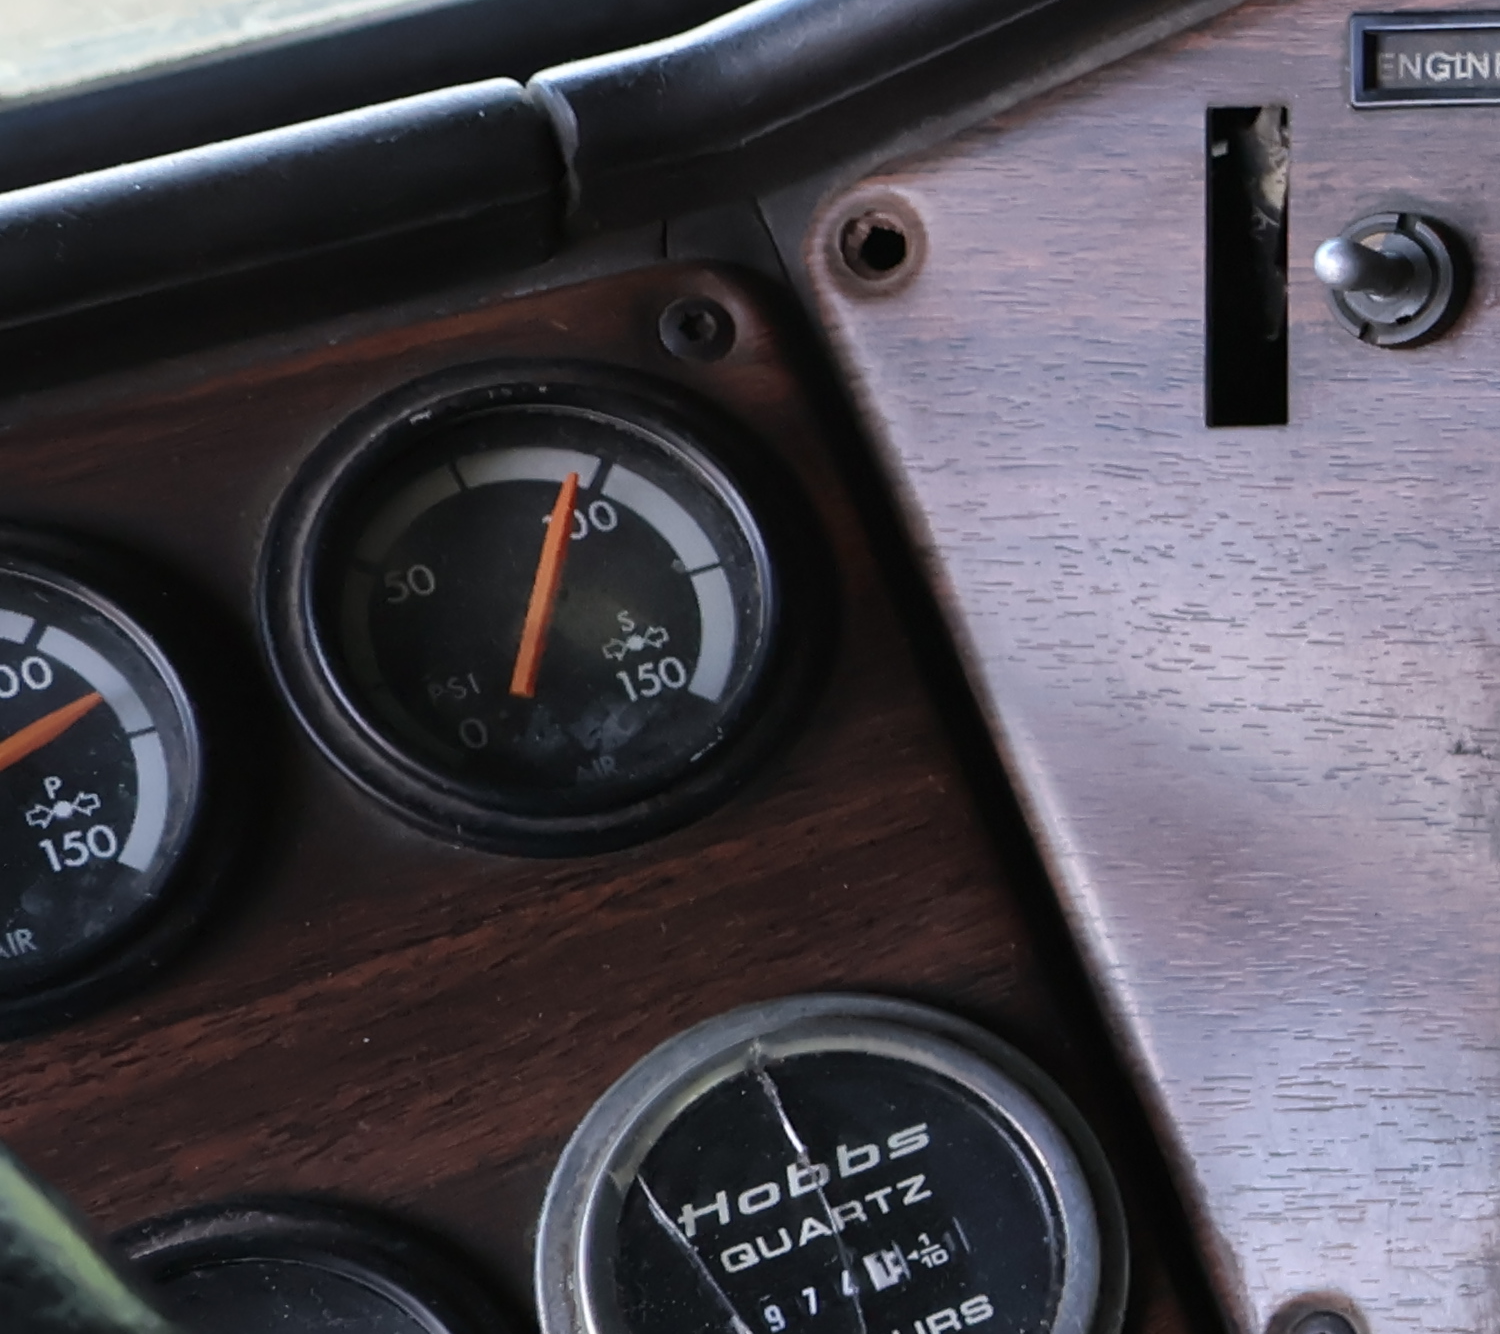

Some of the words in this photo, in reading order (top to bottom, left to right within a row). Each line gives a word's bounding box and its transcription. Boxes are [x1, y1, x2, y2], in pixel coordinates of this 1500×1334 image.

[383, 564, 436, 604] 50
[616, 656, 687, 703] 150
[43, 775, 63, 800] P
[38, 824, 118, 873] 150
[677, 1120, 930, 1237] Hobbs
[720, 1175, 933, 1274] QUARTZ
